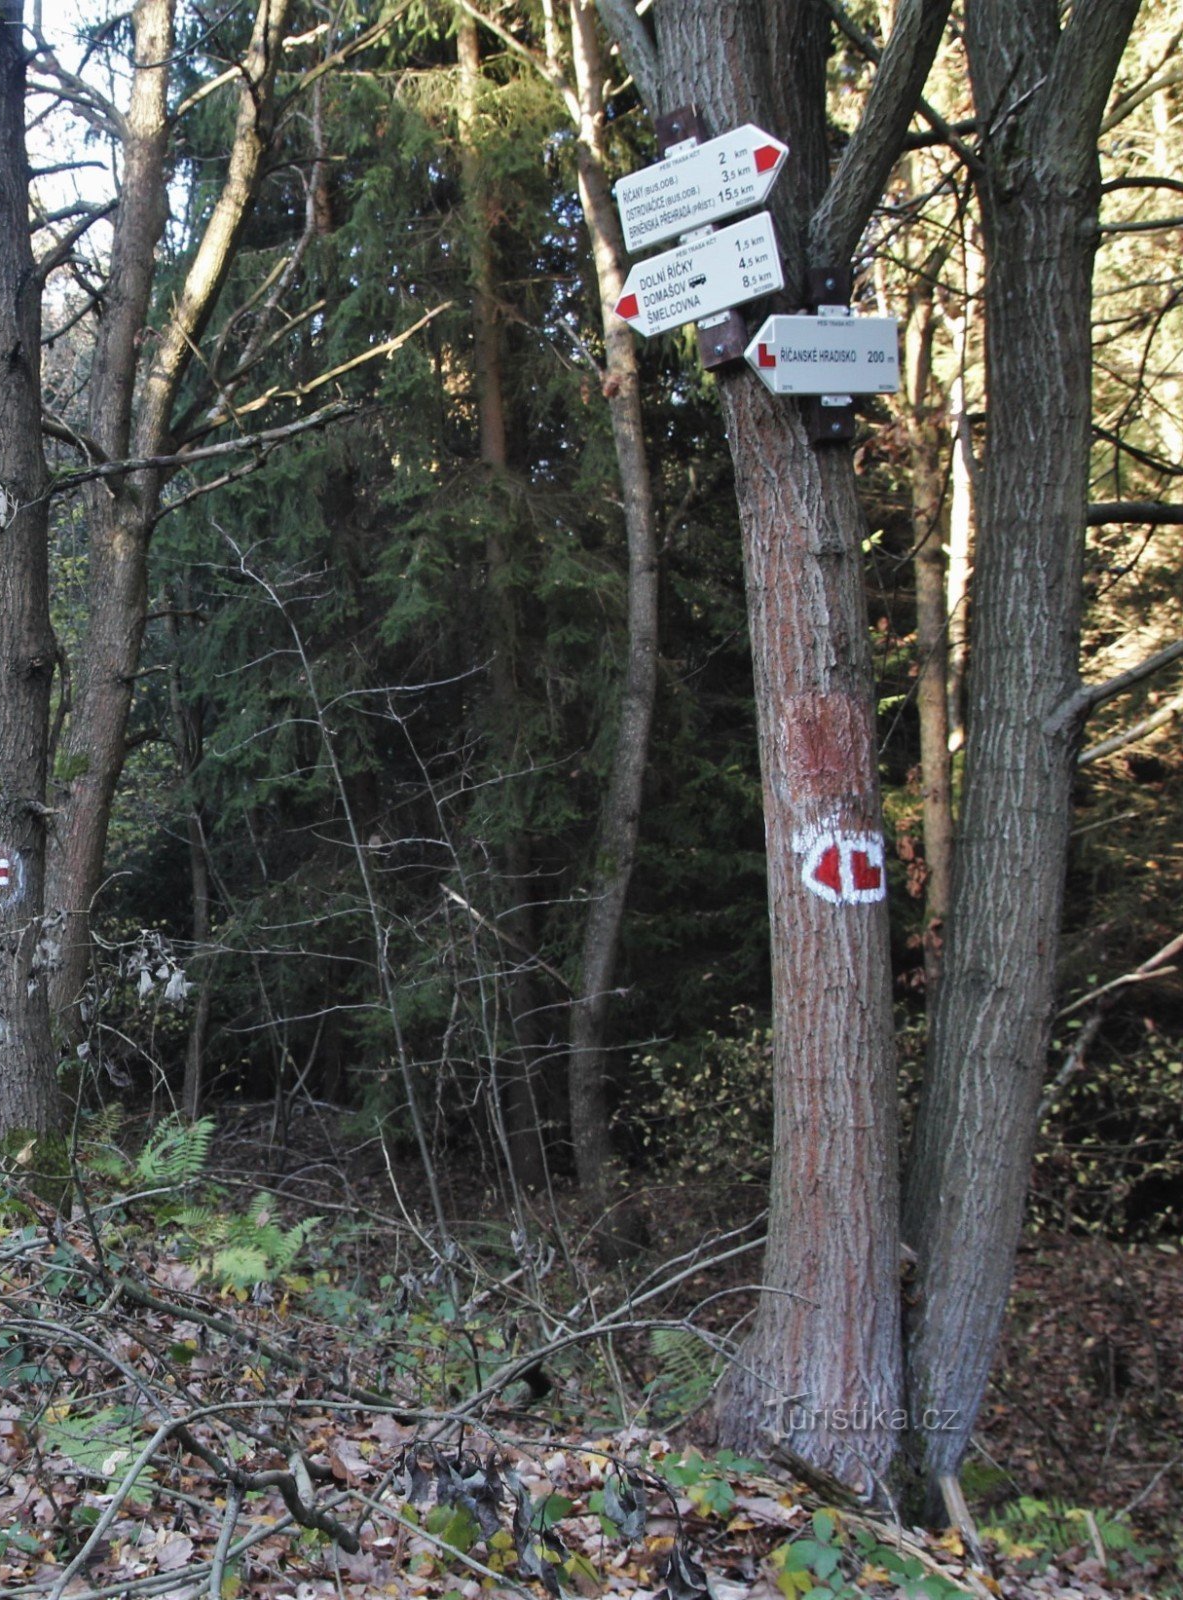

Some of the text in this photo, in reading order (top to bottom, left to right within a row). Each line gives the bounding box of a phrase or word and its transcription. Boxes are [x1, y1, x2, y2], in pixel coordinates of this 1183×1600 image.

[622, 185, 644, 205] ŘÍČANY
[718, 151, 727, 165] 2
[734, 148, 748, 159] km
[626, 196, 665, 222] OSTROVAČICE
[737, 166, 751, 177] km
[628, 214, 660, 240] BRNĚNSKÁ
[659, 202, 691, 226] PŘEHRADA
[741, 184, 754, 195] km
[639, 235, 765, 292] DOLNÍ ŘÍČKY 1,5 km
[642, 253, 769, 309] DOMAŠOV 4,5 km
[646, 294, 701, 325] ŠMELCOVNA
[759, 271, 772, 283] km
[780, 346, 818, 363] ŘÍČANSKÉ
[818, 348, 857, 363] HRADISKO
[867, 349, 885, 363] 200
